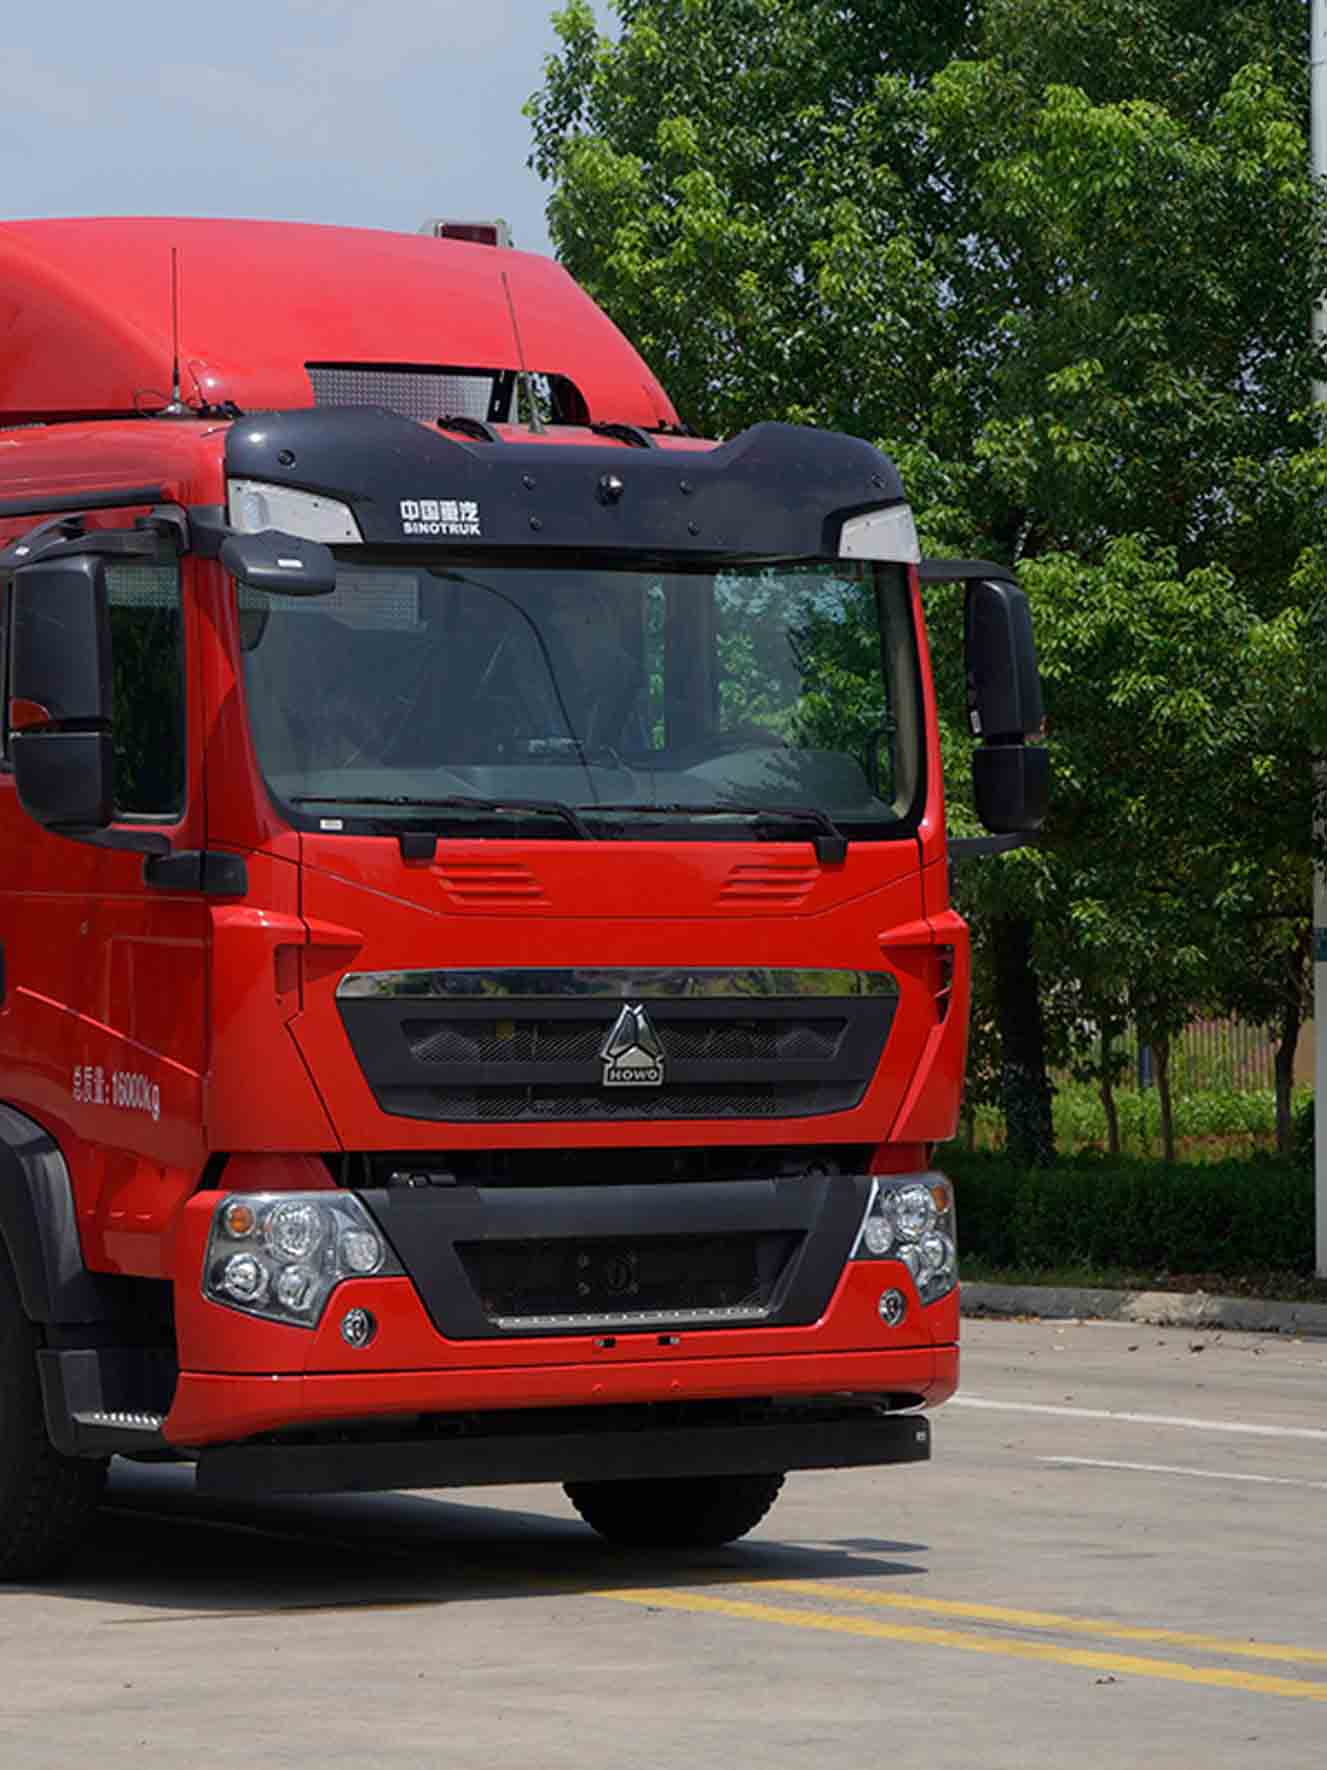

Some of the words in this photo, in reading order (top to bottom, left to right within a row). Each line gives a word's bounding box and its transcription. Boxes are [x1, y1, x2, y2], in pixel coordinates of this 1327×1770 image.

[400, 500, 479, 521] 中国重汽
[403, 522, 481, 535] SINOTRUK
[610, 1069, 658, 1080] HOWO
